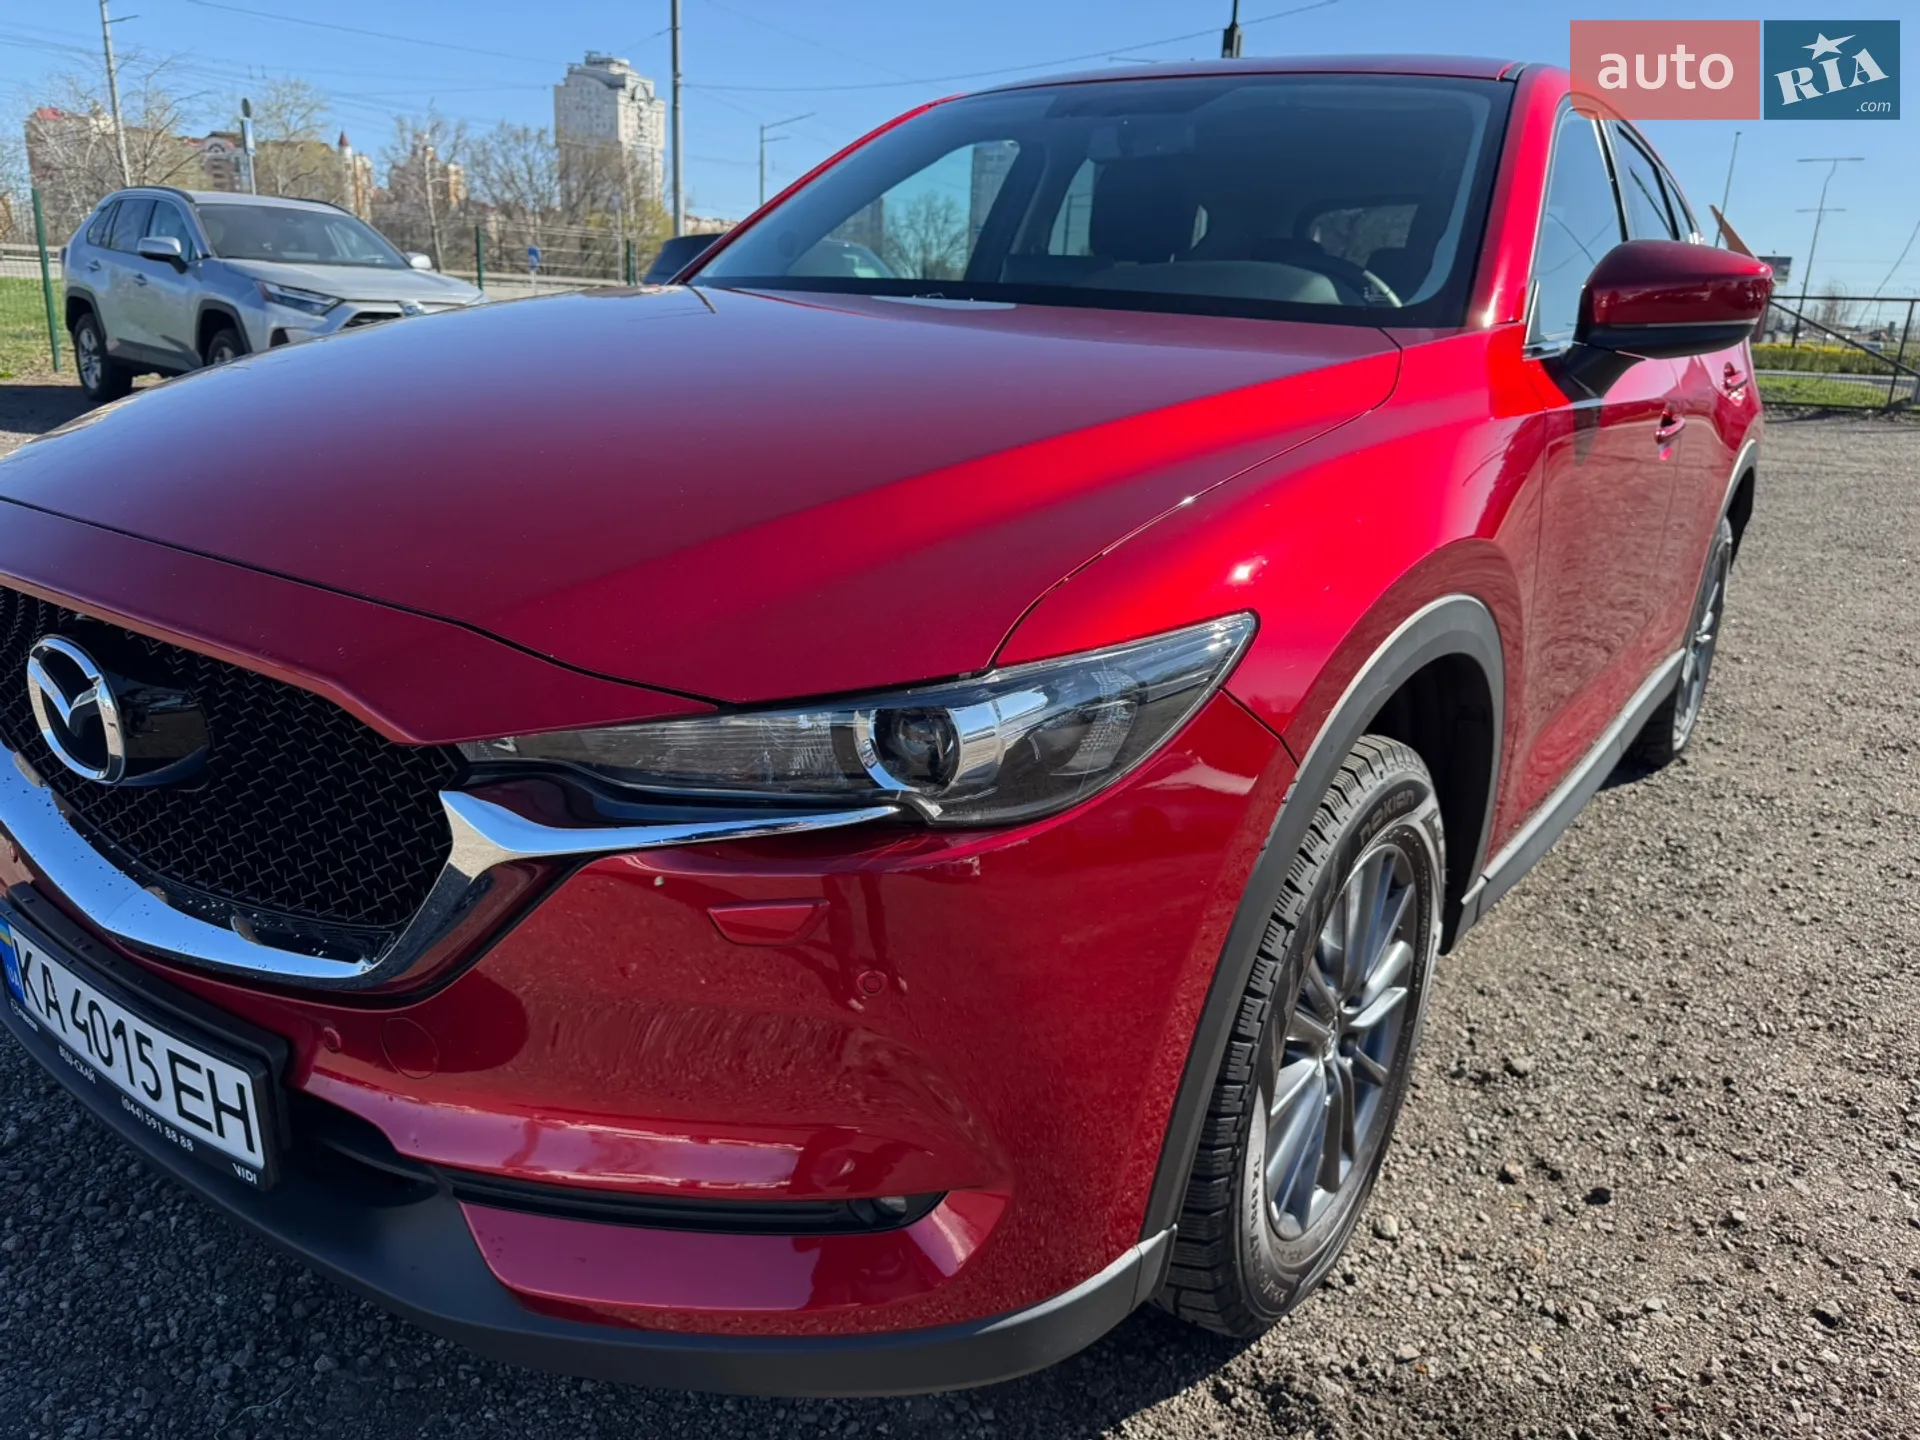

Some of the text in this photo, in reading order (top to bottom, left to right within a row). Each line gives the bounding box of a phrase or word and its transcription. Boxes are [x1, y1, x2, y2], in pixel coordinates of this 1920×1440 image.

[14, 938, 256, 1154] KA 4015 EH
[144, 1113, 162, 1133] 591
[164, 1126, 178, 1143] 88
[179, 1135, 194, 1152] 88
[232, 1162, 258, 1185] VIDI
